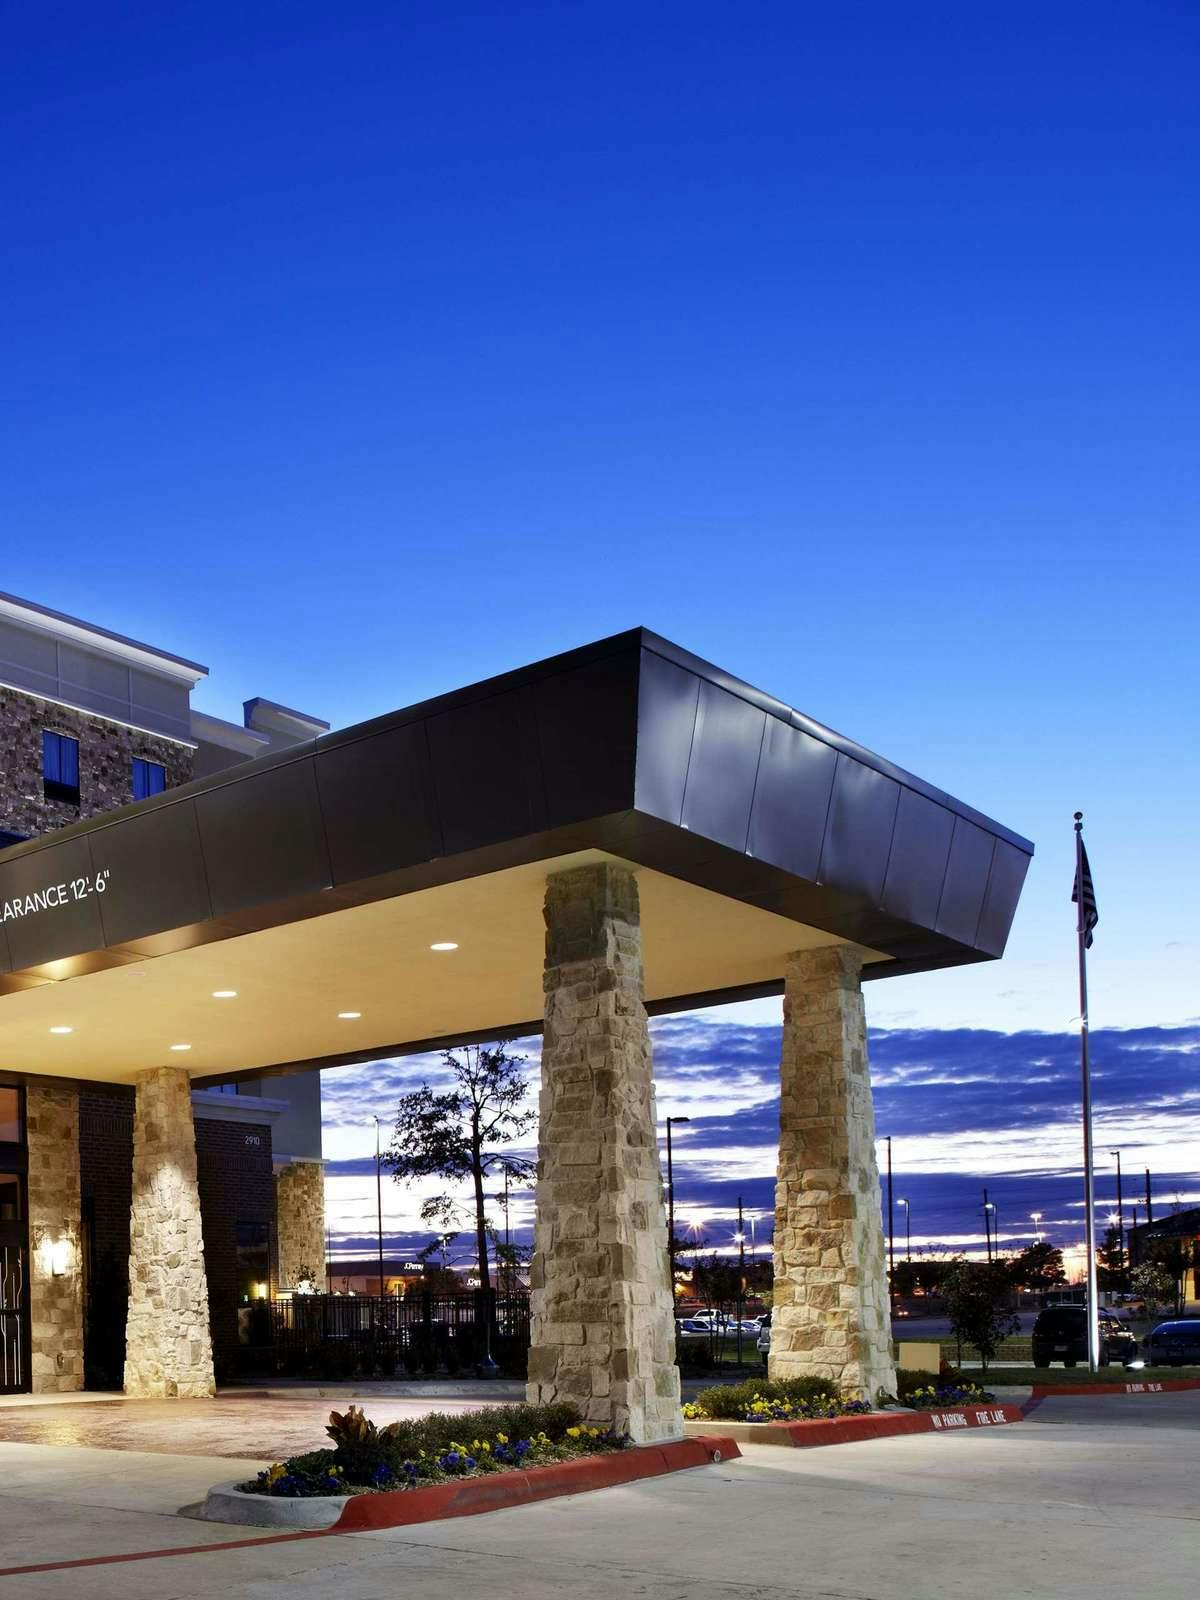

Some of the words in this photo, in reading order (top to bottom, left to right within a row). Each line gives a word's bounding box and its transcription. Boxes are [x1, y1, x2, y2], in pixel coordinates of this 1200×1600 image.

[244, 1135, 260, 1145] 2910
[931, 1414, 942, 1428] NO
[942, 1413, 967, 1426] PARKING
[990, 1410, 1007, 1423] LANE
